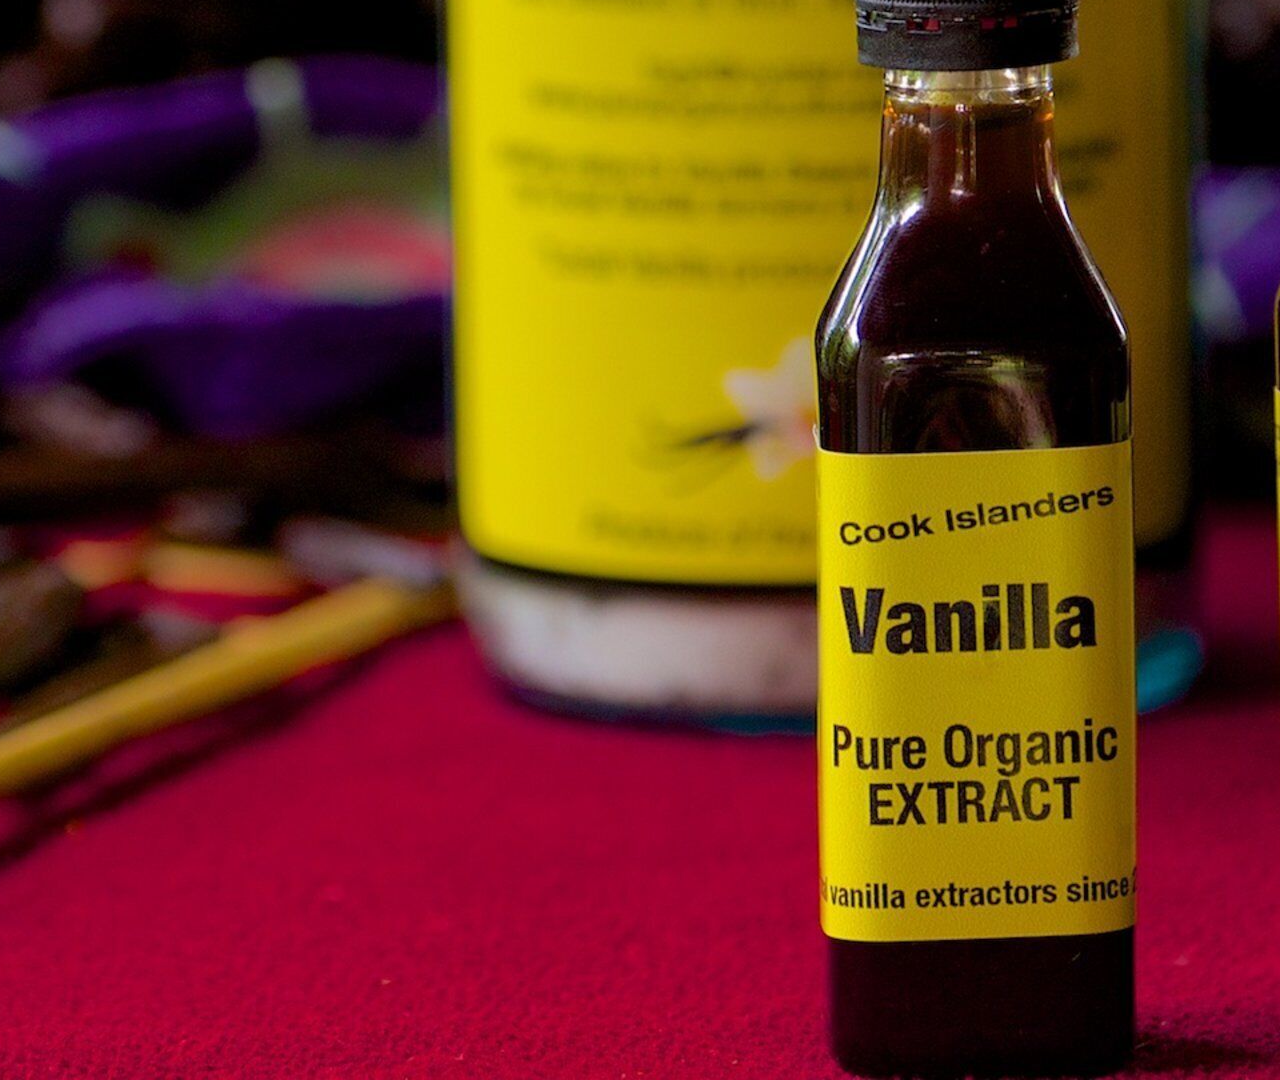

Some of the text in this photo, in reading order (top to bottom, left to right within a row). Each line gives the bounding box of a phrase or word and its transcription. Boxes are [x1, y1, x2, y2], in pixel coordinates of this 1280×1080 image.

[840, 514, 934, 545] Cook
[945, 486, 1114, 531] Islanders
[840, 583, 1097, 654] Vanilla
[833, 719, 1118, 776] Pure Organic
[869, 776, 1080, 826] EXTRACT
[830, 883, 905, 909] vanilla
[916, 880, 1057, 908] extractors
[1067, 875, 1129, 902] since
